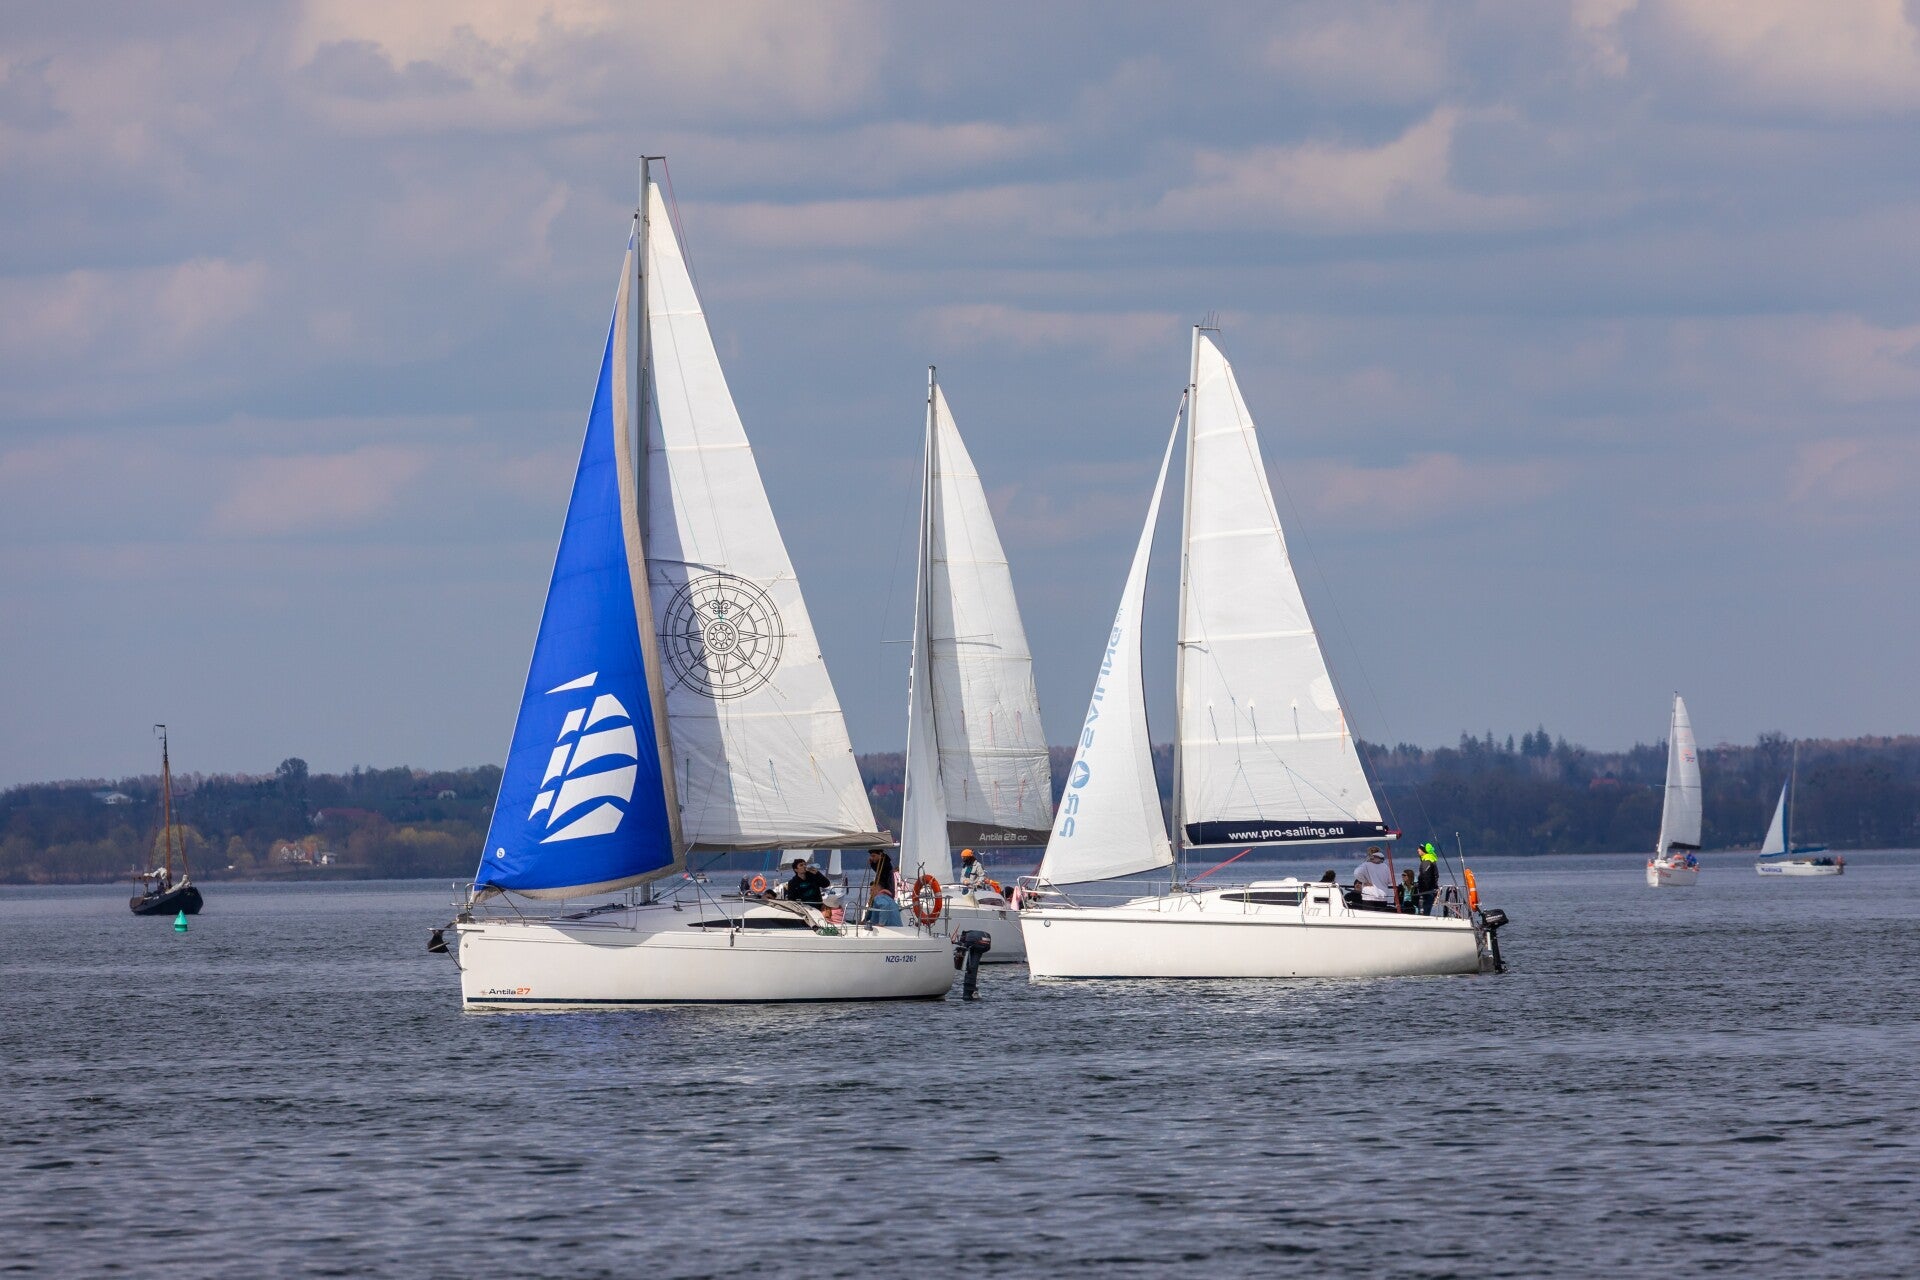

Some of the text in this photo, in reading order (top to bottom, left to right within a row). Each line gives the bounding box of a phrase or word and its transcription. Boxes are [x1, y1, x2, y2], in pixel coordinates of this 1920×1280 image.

[979, 833, 1002, 841] Antila
[1228, 826, 1344, 840] www.pro-sailing.eu
[885, 955, 917, 963] NZG-1261
